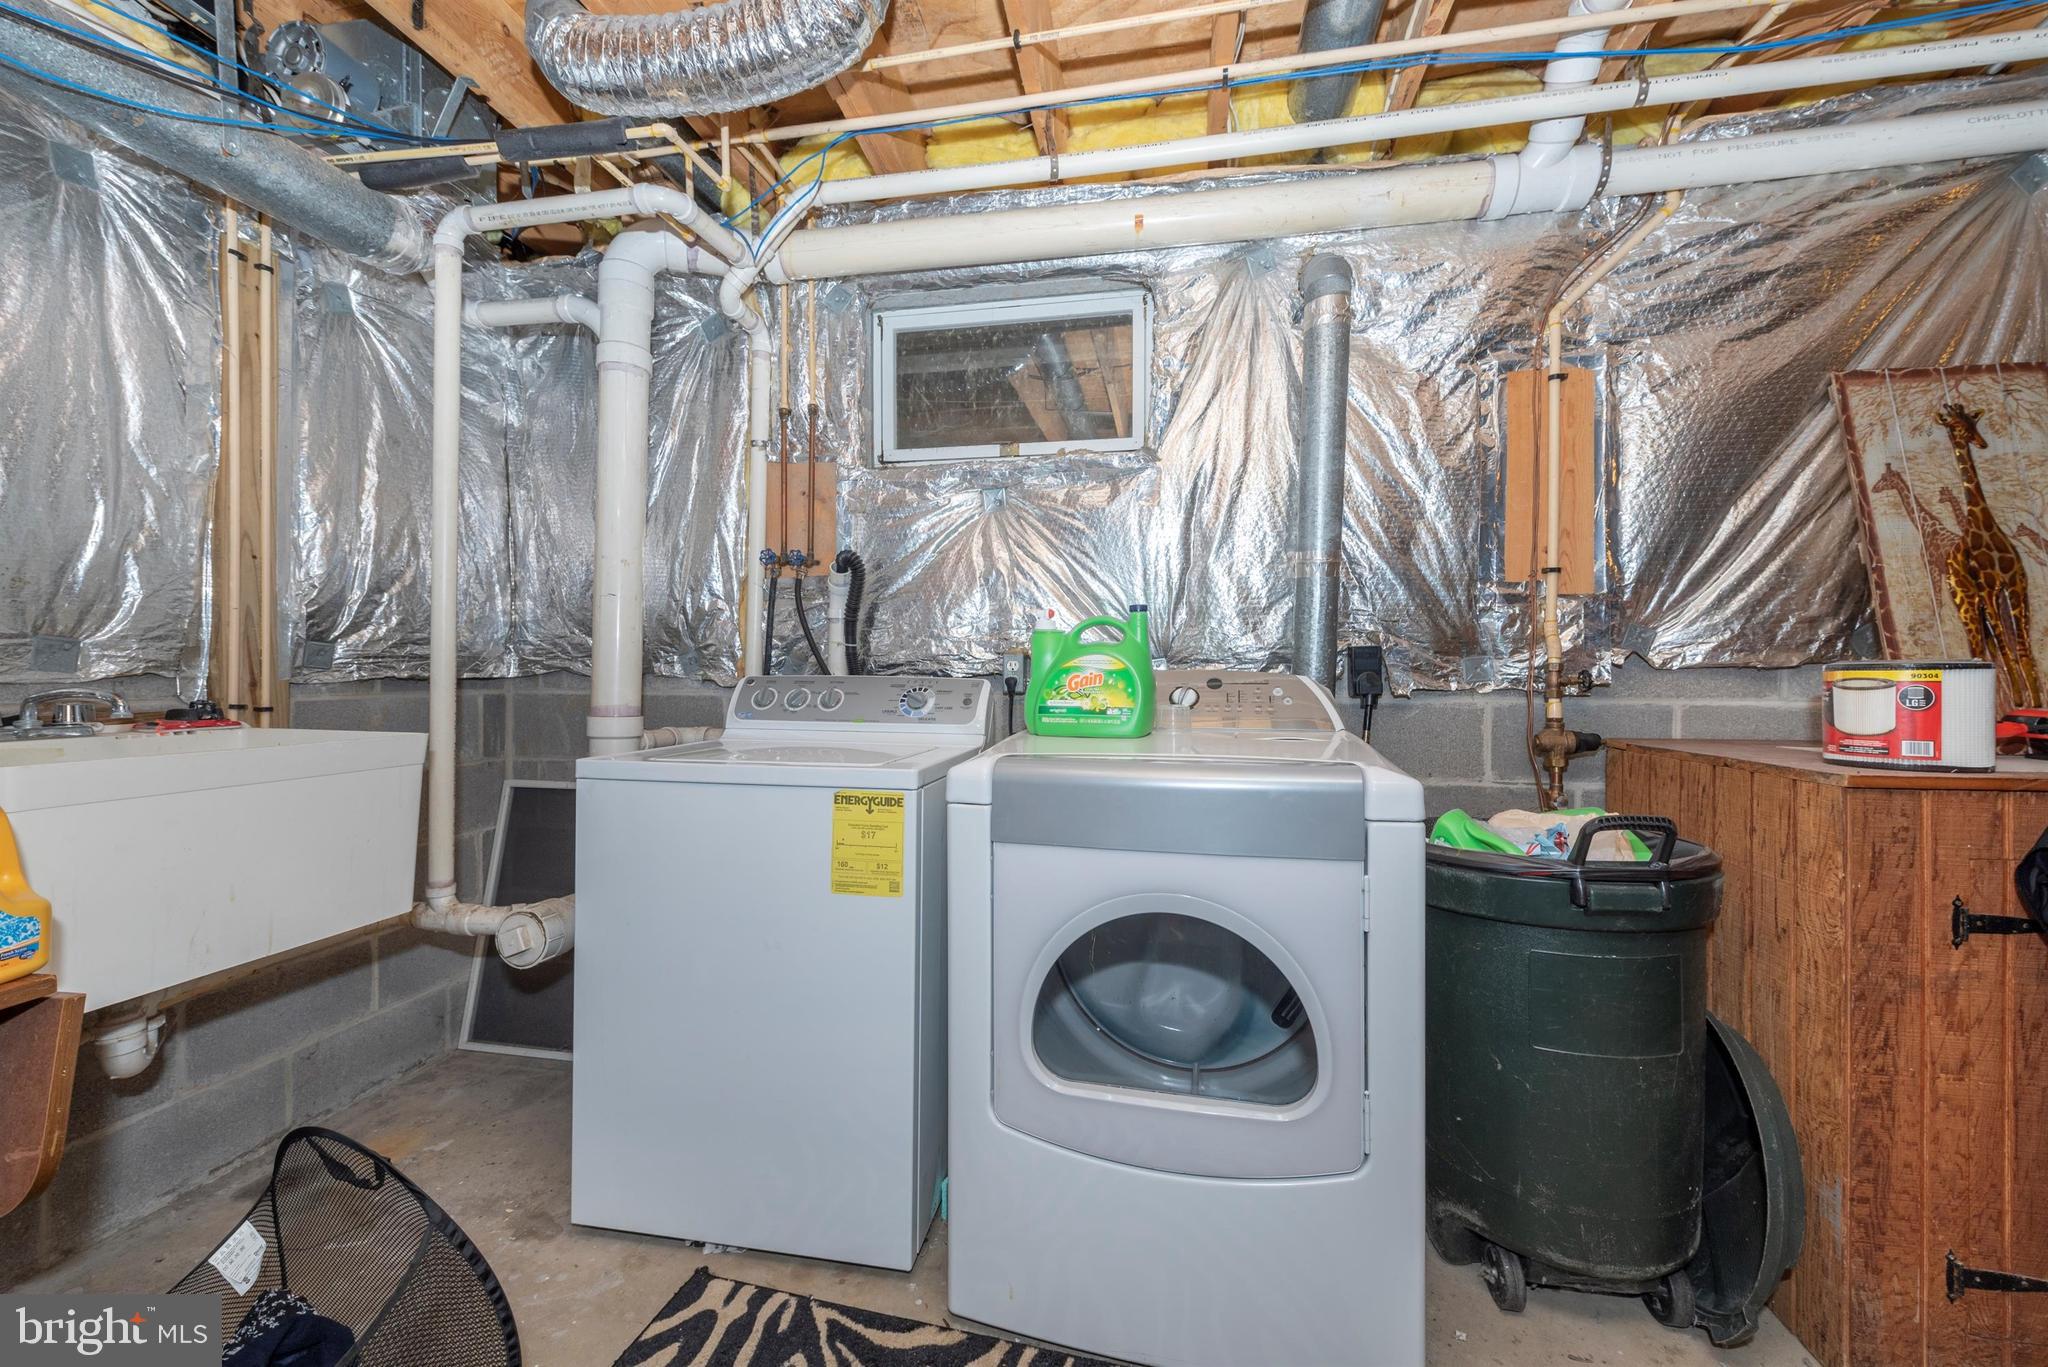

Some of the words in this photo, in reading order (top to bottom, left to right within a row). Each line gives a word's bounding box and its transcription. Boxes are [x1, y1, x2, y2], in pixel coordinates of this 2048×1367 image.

[1649, 71, 1729, 85] CHARLOTT
[1966, 108, 2048, 125] CHARLOTT
[1657, 151, 1683, 161] NOT
[1692, 146, 1719, 157] FOR
[1727, 136, 1800, 152] PRESSURE
[1066, 672, 1104, 692] Gain
[834, 794, 904, 808] ENERGYGUIDE
